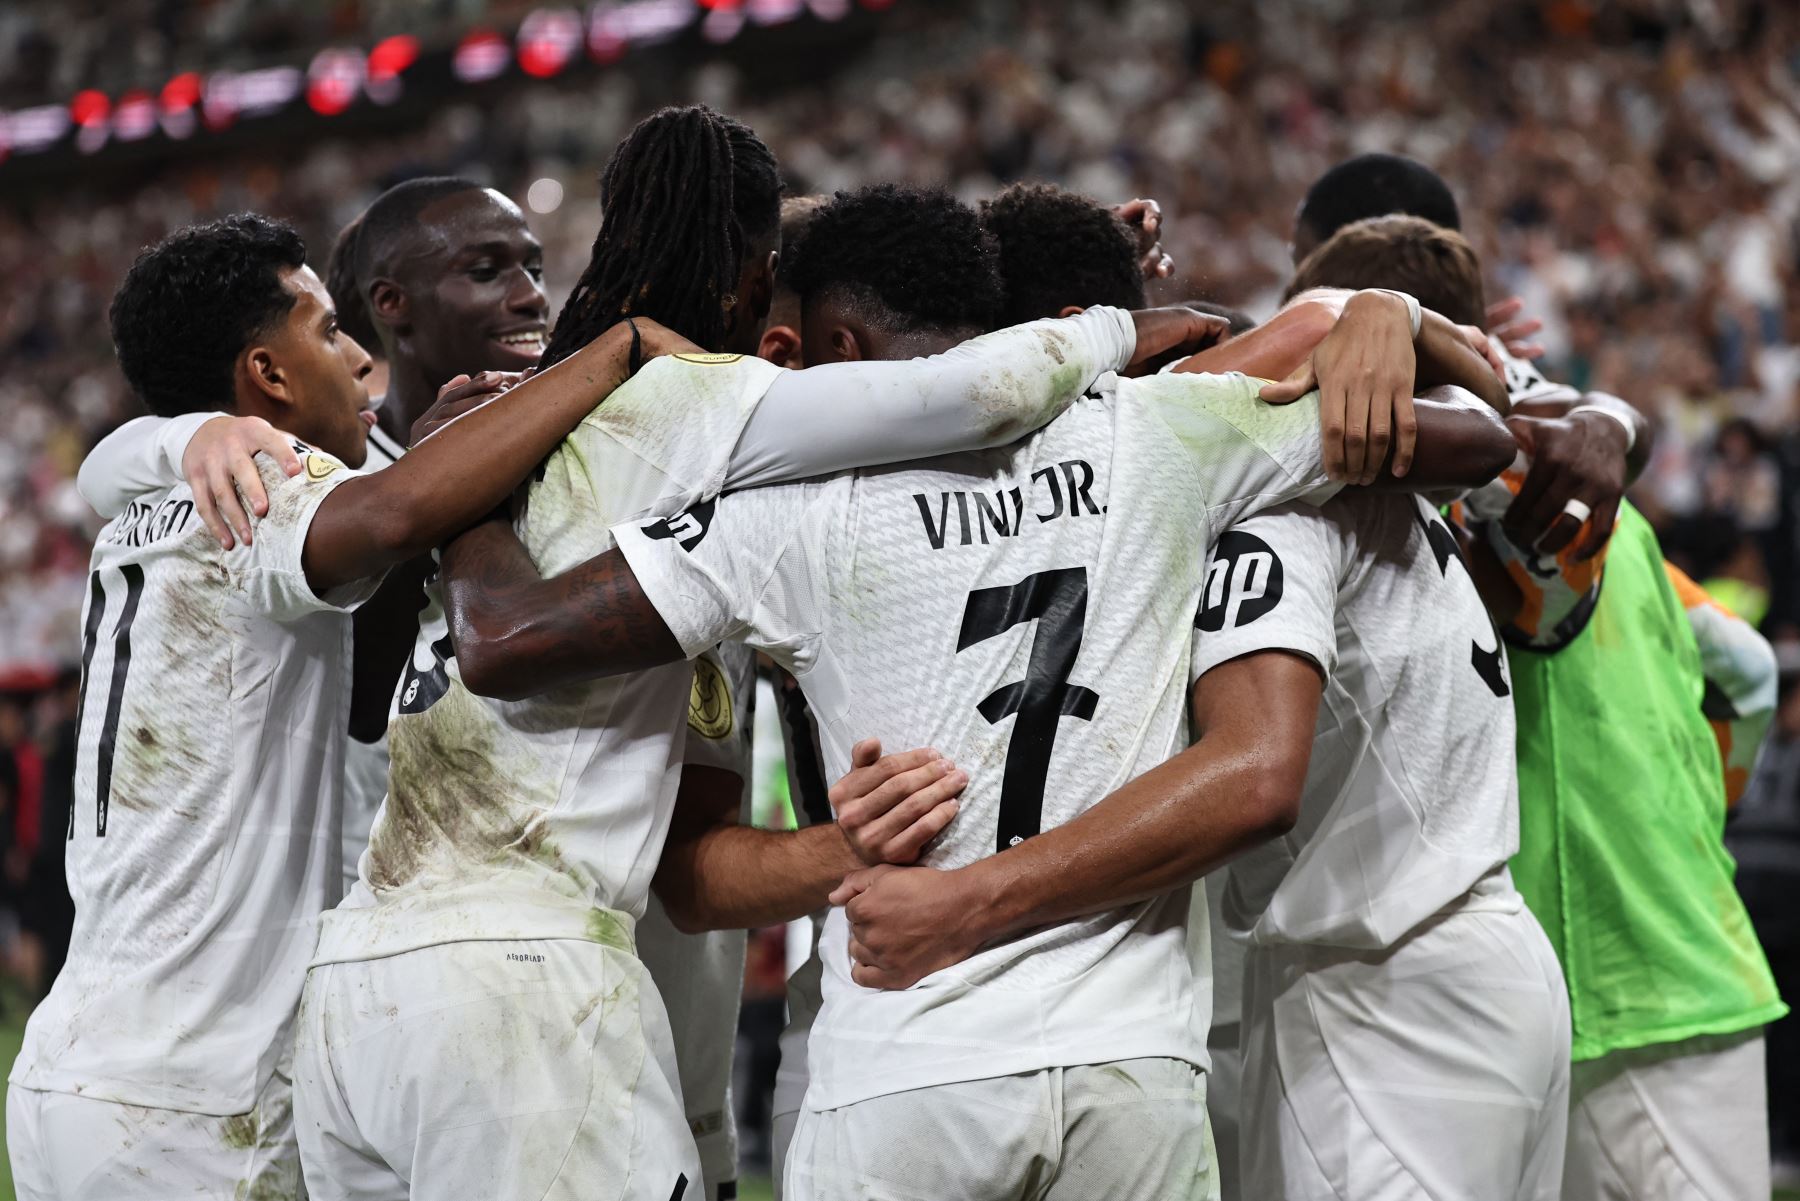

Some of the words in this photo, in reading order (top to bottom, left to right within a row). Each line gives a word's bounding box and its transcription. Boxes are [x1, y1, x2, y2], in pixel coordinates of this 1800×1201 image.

[913, 486, 1023, 550] VINI
[1031, 459, 1108, 524] JR.
[68, 562, 145, 841] 11
[956, 566, 1100, 852] 7
